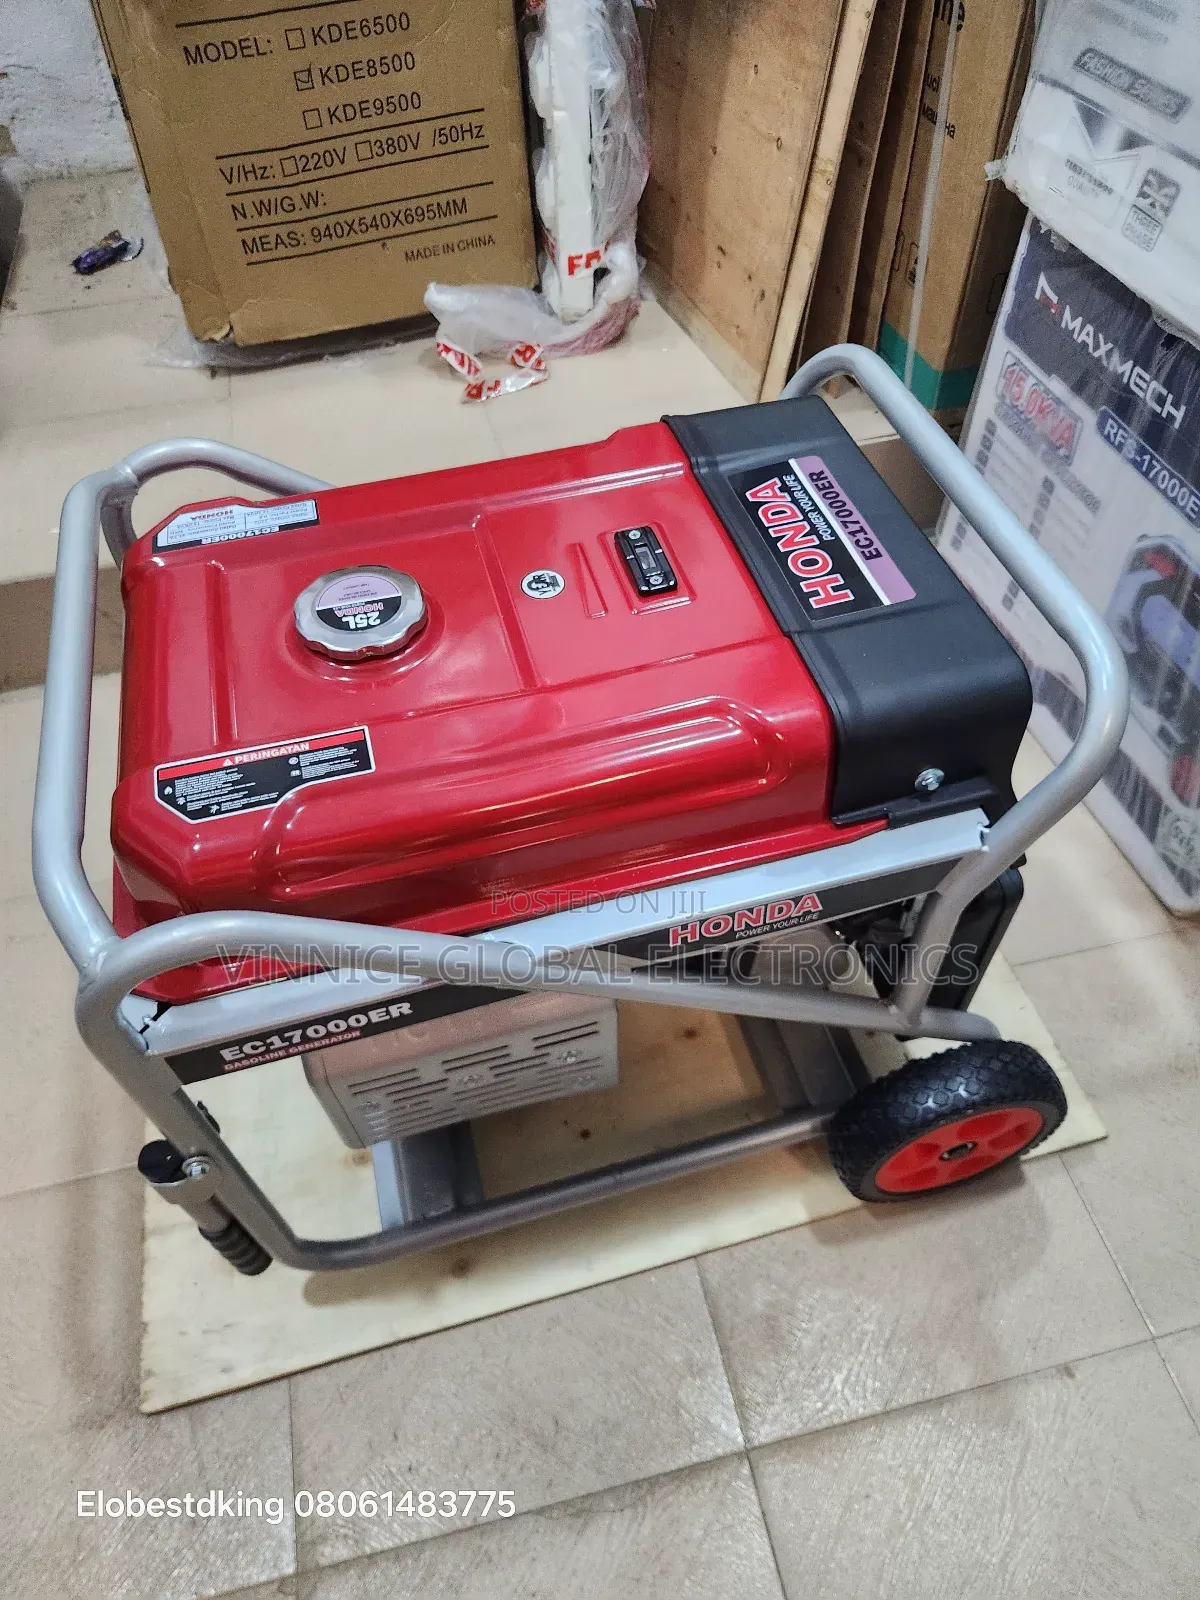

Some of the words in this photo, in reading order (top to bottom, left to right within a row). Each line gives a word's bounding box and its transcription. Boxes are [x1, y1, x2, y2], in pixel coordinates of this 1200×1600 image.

[183, 36, 273, 66] MODEL:
[311, 12, 411, 46] KDE6500
[319, 51, 416, 86] KDE8500
[327, 91, 421, 125] KDE9500
[219, 163, 276, 185] V/Hz:
[300, 147, 346, 173] 220V
[374, 132, 420, 157] 380V
[432, 122, 485, 148] /50Hz
[231, 190, 327, 221] N.W/G.W:
[241, 230, 306, 255] MEAS:
[311, 197, 467, 243] 940X540X695MM
[404, 244, 440, 262] MADE
[442, 242, 455, 254] IN
[457, 235, 496, 251] CHINA
[1061, 304, 1187, 430] MAXMECH
[782, 474, 801, 492] LIFE
[793, 490, 813, 513] YOUR
[808, 469, 883, 561] EC17000ER
[745, 477, 855, 609] HONDA
[808, 512, 835, 541] POWER
[334, 602, 384, 618] HONDA
[342, 611, 381, 630] 25L
[234, 743, 310, 765] PERINGATAN
[669, 893, 823, 947] HONDA
[735, 925, 770, 939] POWER
[773, 917, 798, 930] YOUR
[799, 912, 819, 924] LIFE
[220, 1002, 413, 1062] EC17000ER
[224, 1050, 287, 1072] GASOLINE
[289, 1030, 361, 1054] GENERATOR
